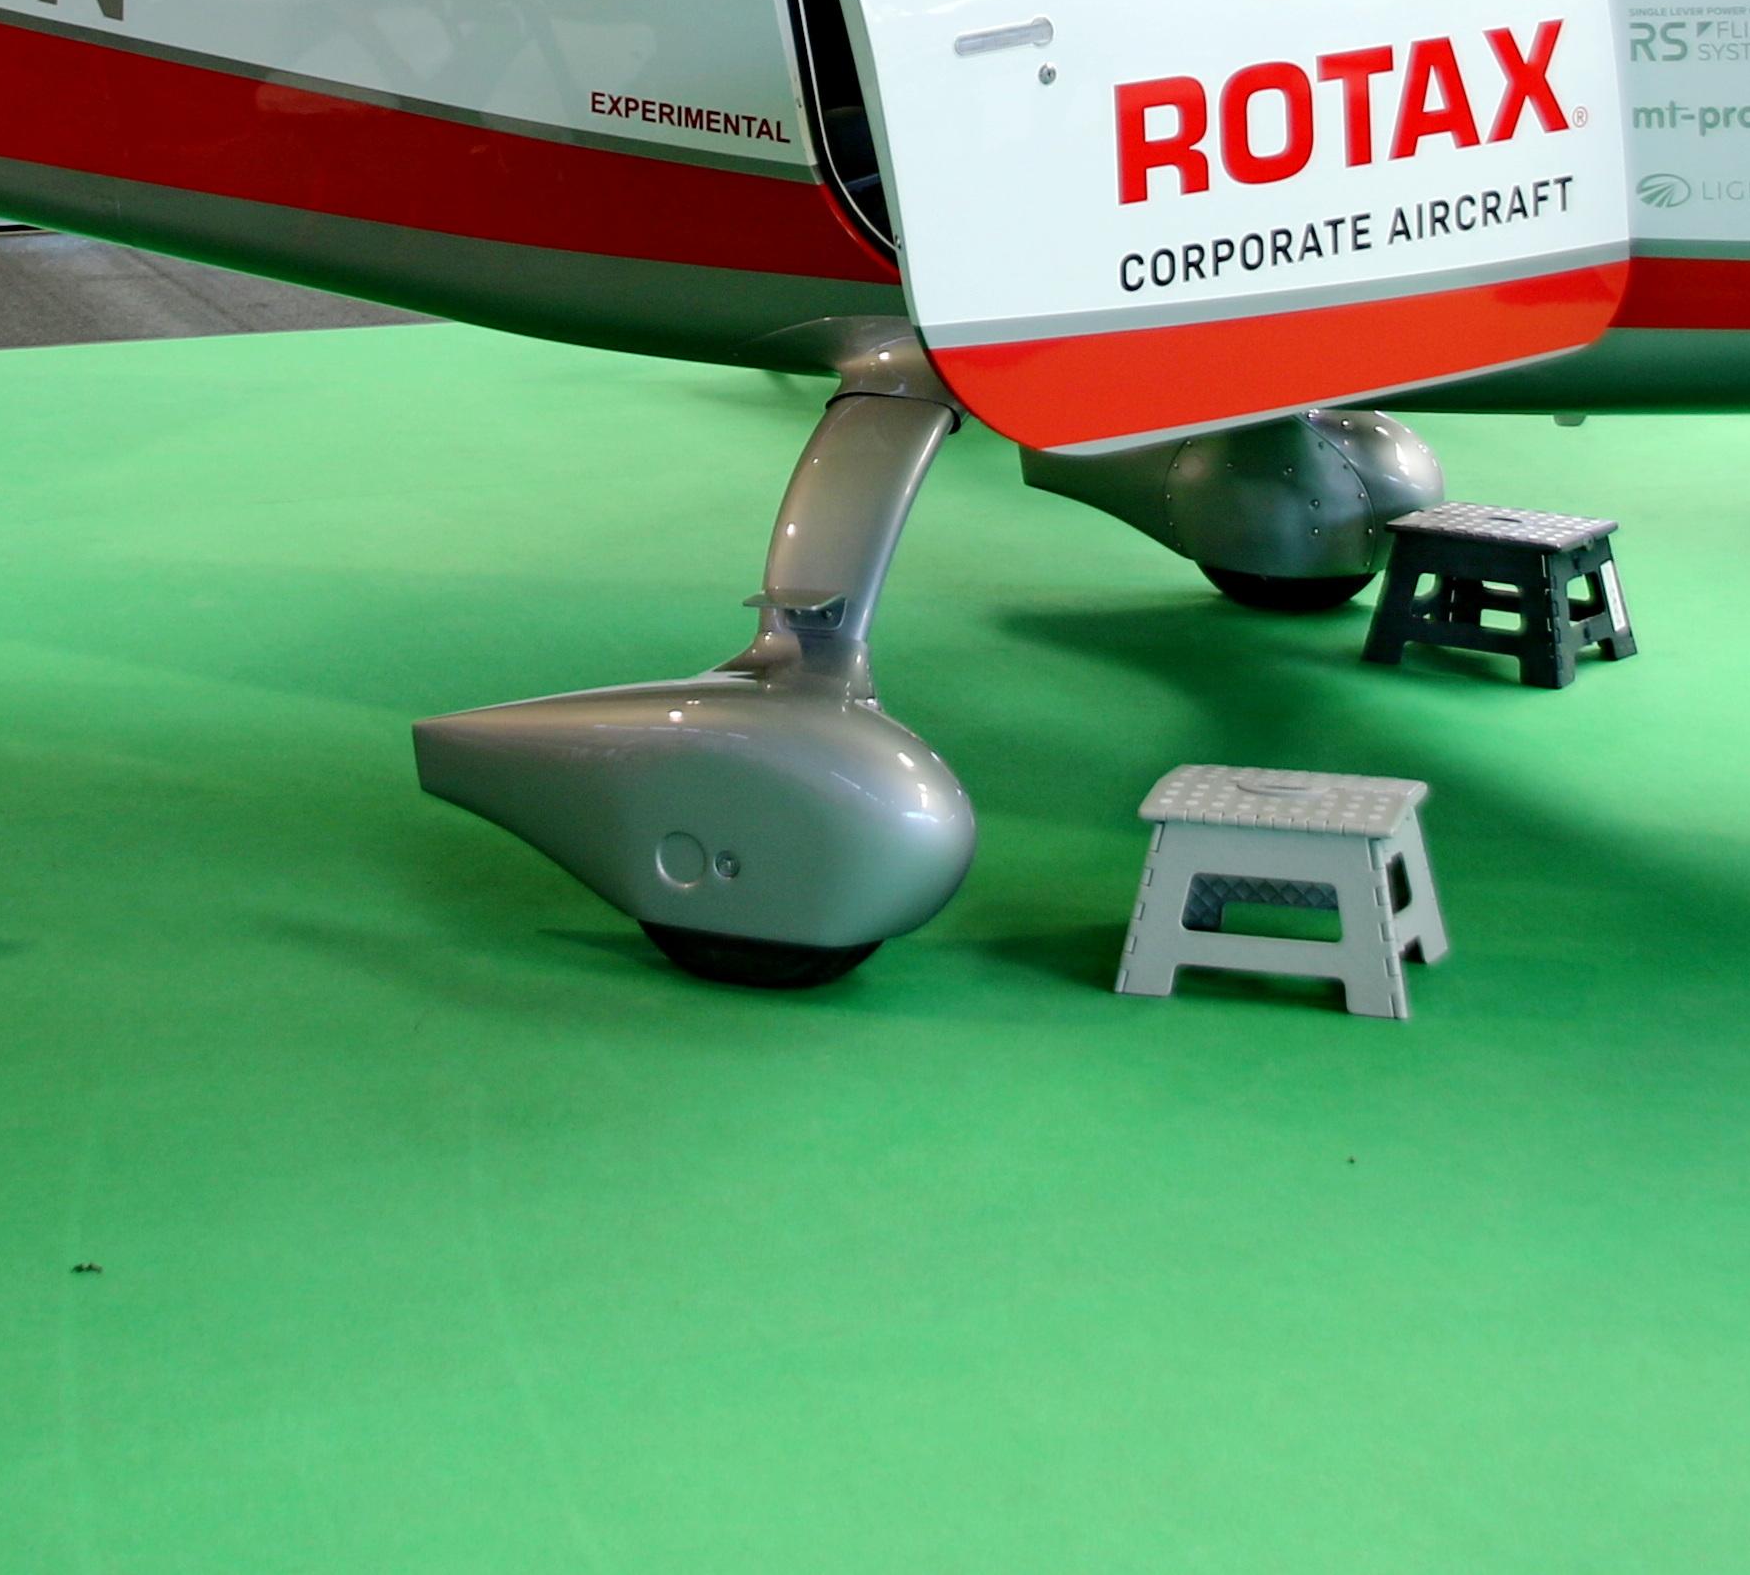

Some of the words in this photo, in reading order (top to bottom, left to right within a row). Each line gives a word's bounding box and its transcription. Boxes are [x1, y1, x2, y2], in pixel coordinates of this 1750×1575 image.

[1629, 7, 1666, 17] SINGLE
[1670, 7, 1703, 16] LEVER
[1707, 6, 1747, 15] POWER
[1629, 22, 1688, 62] RS
[590, 91, 791, 144] EXPERIMENTAL
[1120, 212, 1373, 292] CORPORATE
[1388, 175, 1574, 245] AIRCRAFT
